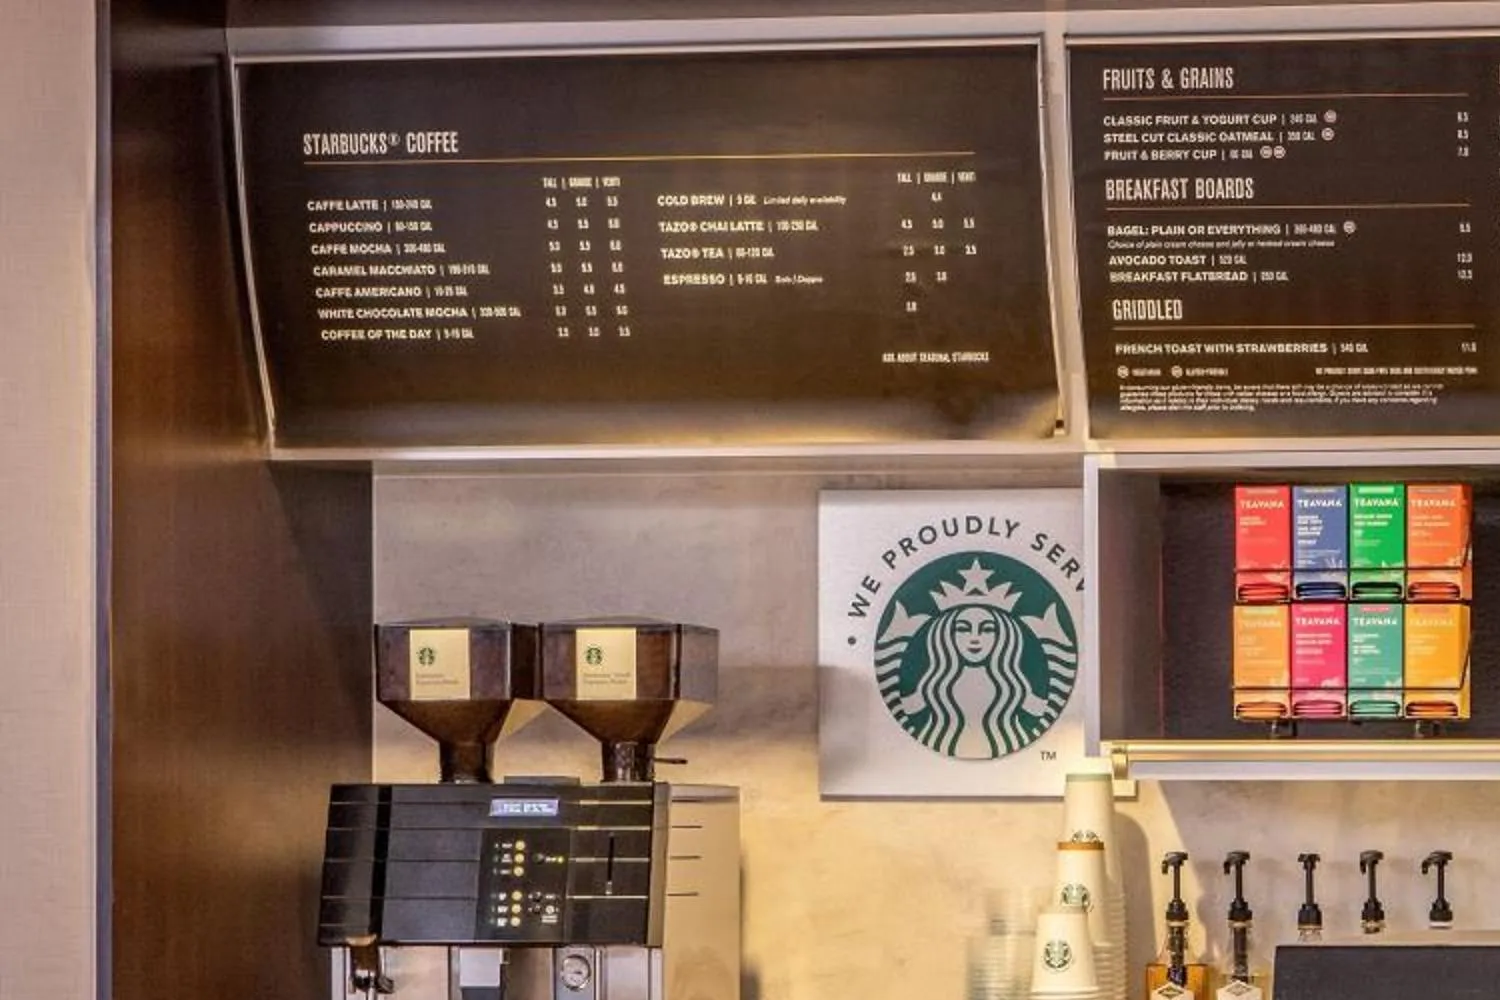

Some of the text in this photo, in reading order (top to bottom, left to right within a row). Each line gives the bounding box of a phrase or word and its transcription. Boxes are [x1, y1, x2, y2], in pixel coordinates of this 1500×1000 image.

[1103, 67, 1234, 90] FRUITS & GRAINS
[1104, 114, 1277, 126] CLASSIC FRUIT & YOGURT CUP
[406, 131, 459, 153] COFFEE
[1104, 132, 1274, 144] STEEL CUT CLASSIC OATMEAL
[1104, 150, 1138, 161] FRUIT
[1151, 150, 1190, 160] BERRY
[1192, 150, 1217, 160] CUP
[1106, 178, 1254, 200] BREAKFAST BOARDS
[307, 200, 379, 211] CAFFE LATTE
[657, 195, 726, 206] COLD BREW
[309, 221, 382, 233] CAPPUCCINO
[700, 221, 728, 232] CHAI
[730, 220, 764, 232] LATTE
[1108, 224, 1281, 236] BAGEL: PLAIN OR EVERYTHING
[312, 244, 392, 255] CAFFE MOCHA
[702, 248, 724, 258] TEA
[1110, 254, 1206, 266] AVOCADO TOAST
[313, 264, 436, 276] CARAMEL MACCHIATO
[663, 274, 726, 285] ESPRESSO
[1110, 271, 1248, 282] BREAKFAST FLATBREAD
[316, 286, 422, 298] CAFFE AMERICANO
[318, 307, 468, 319] WHITE CHOCOLATE MOCHA
[1112, 299, 1182, 320] GRIDDLED
[321, 329, 431, 340] COFFEE OF THE DAY
[1115, 343, 1328, 354] FRENCH TOAST WITH STRAWBERRIES
[1241, 500, 1284, 510] TEAVANA
[1297, 499, 1342, 508] TEAVANA
[1354, 498, 1399, 507] TEAVANA
[848, 575, 882, 620] WE
[882, 516, 1020, 570] PROUDLY
[1353, 618, 1397, 626] TEAVANA
[1040, 752, 1056, 760] TM
